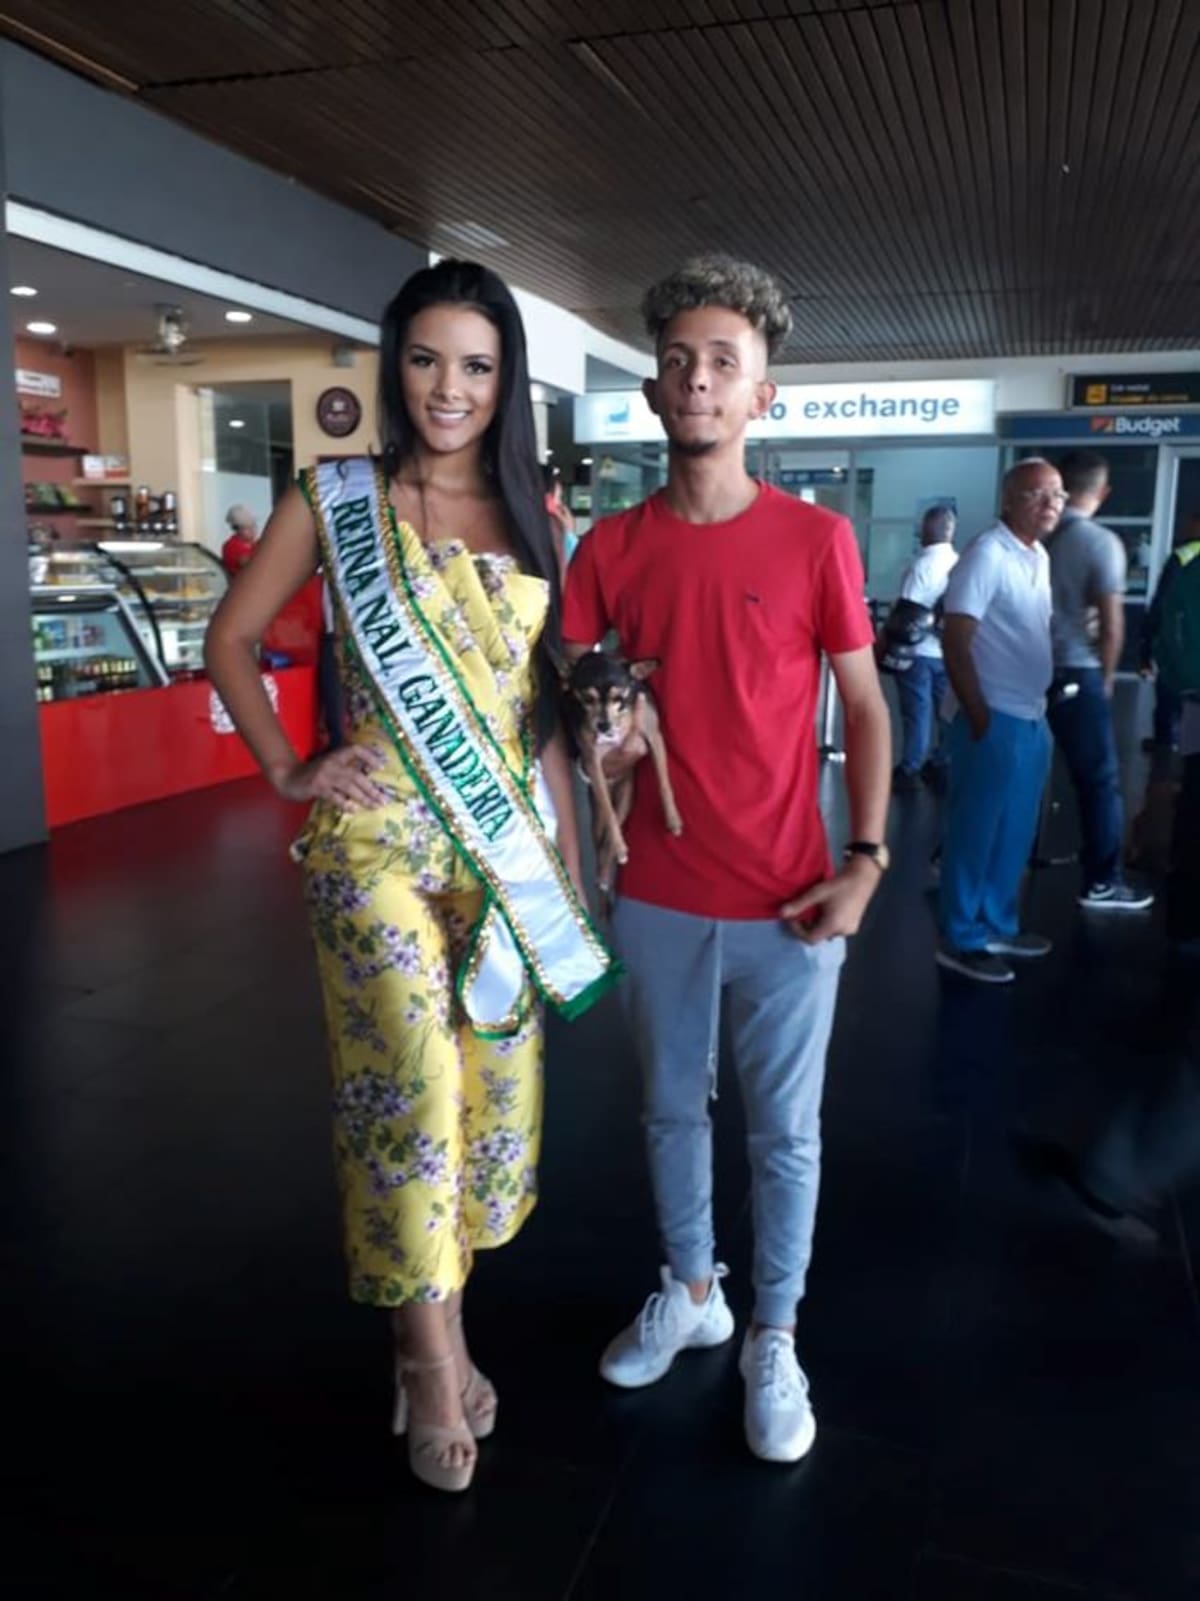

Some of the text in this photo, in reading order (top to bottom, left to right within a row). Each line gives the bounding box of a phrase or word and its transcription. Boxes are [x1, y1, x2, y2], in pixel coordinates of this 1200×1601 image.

[803, 393, 960, 422] exchange
[1116, 416, 1180, 437] Budget
[332, 496, 379, 598] REINA
[398, 674, 514, 842] GANADERIA
